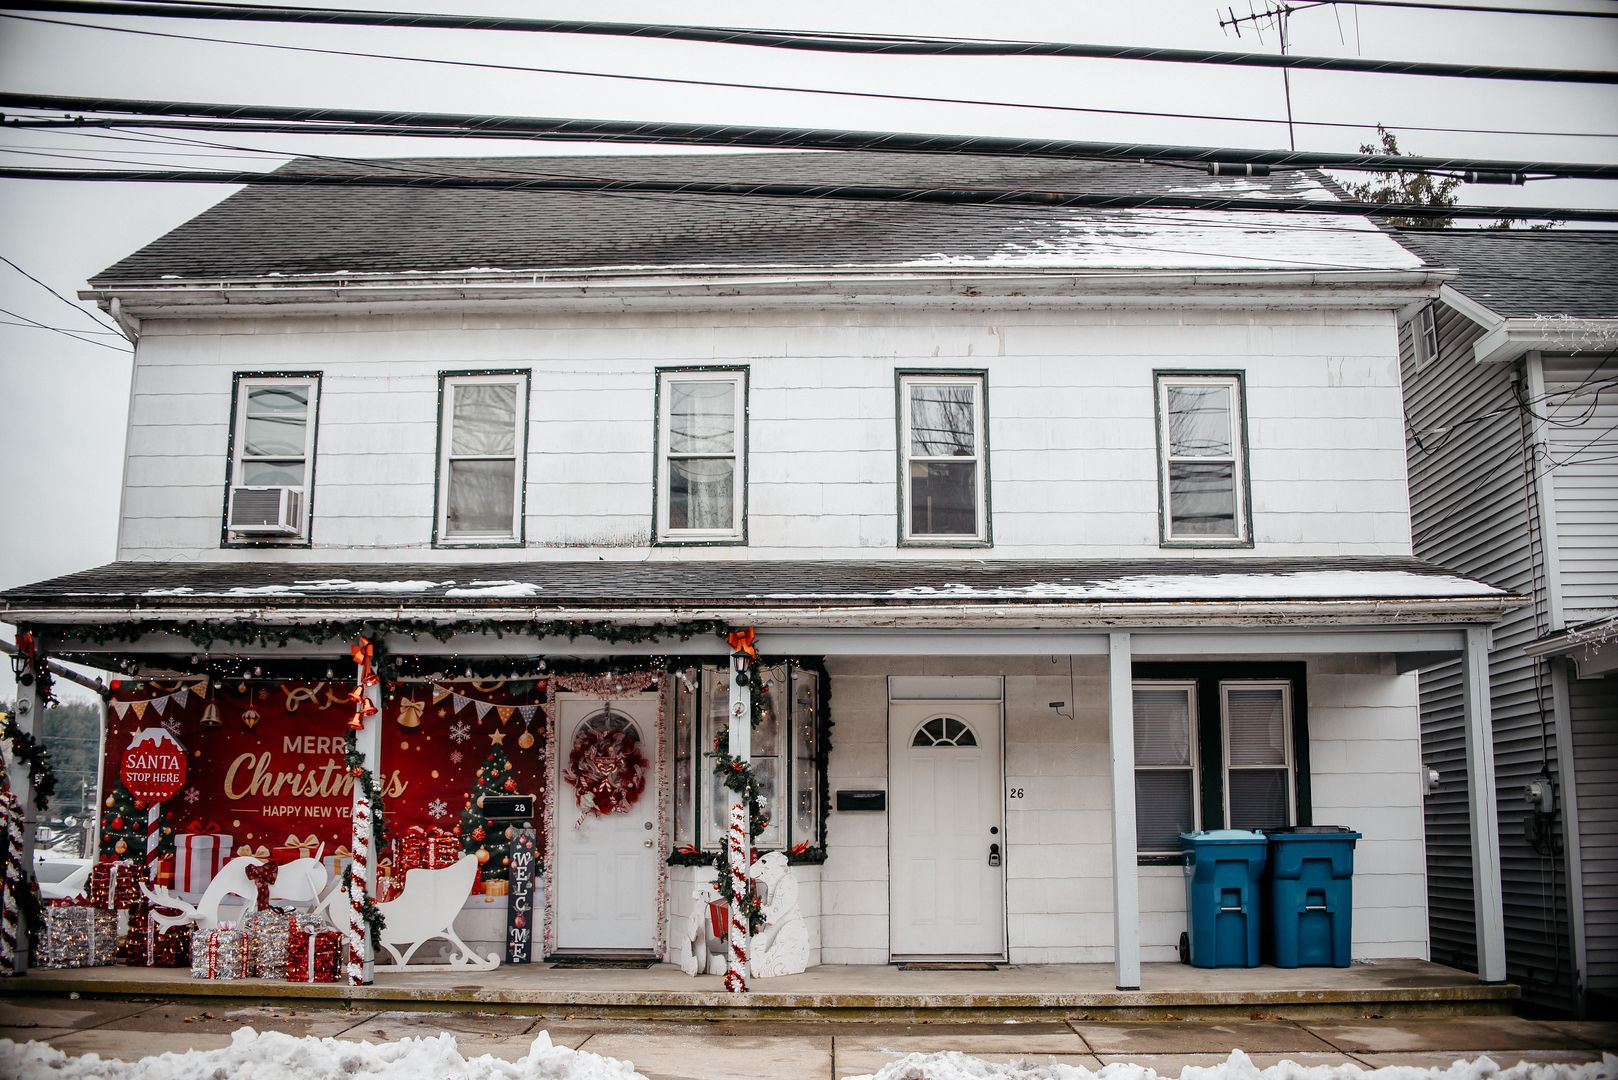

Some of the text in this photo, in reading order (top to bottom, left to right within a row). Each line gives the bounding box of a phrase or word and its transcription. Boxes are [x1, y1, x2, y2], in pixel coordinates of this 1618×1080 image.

[283, 736, 346, 754] MERR
[127, 754, 180, 770] SANTA
[126, 772, 180, 783] STOP HERE
[224, 751, 409, 800] Christms
[1010, 788, 1024, 799] 26
[262, 805, 354, 818] HAPPY NEW YE
[514, 803, 526, 812] 28
